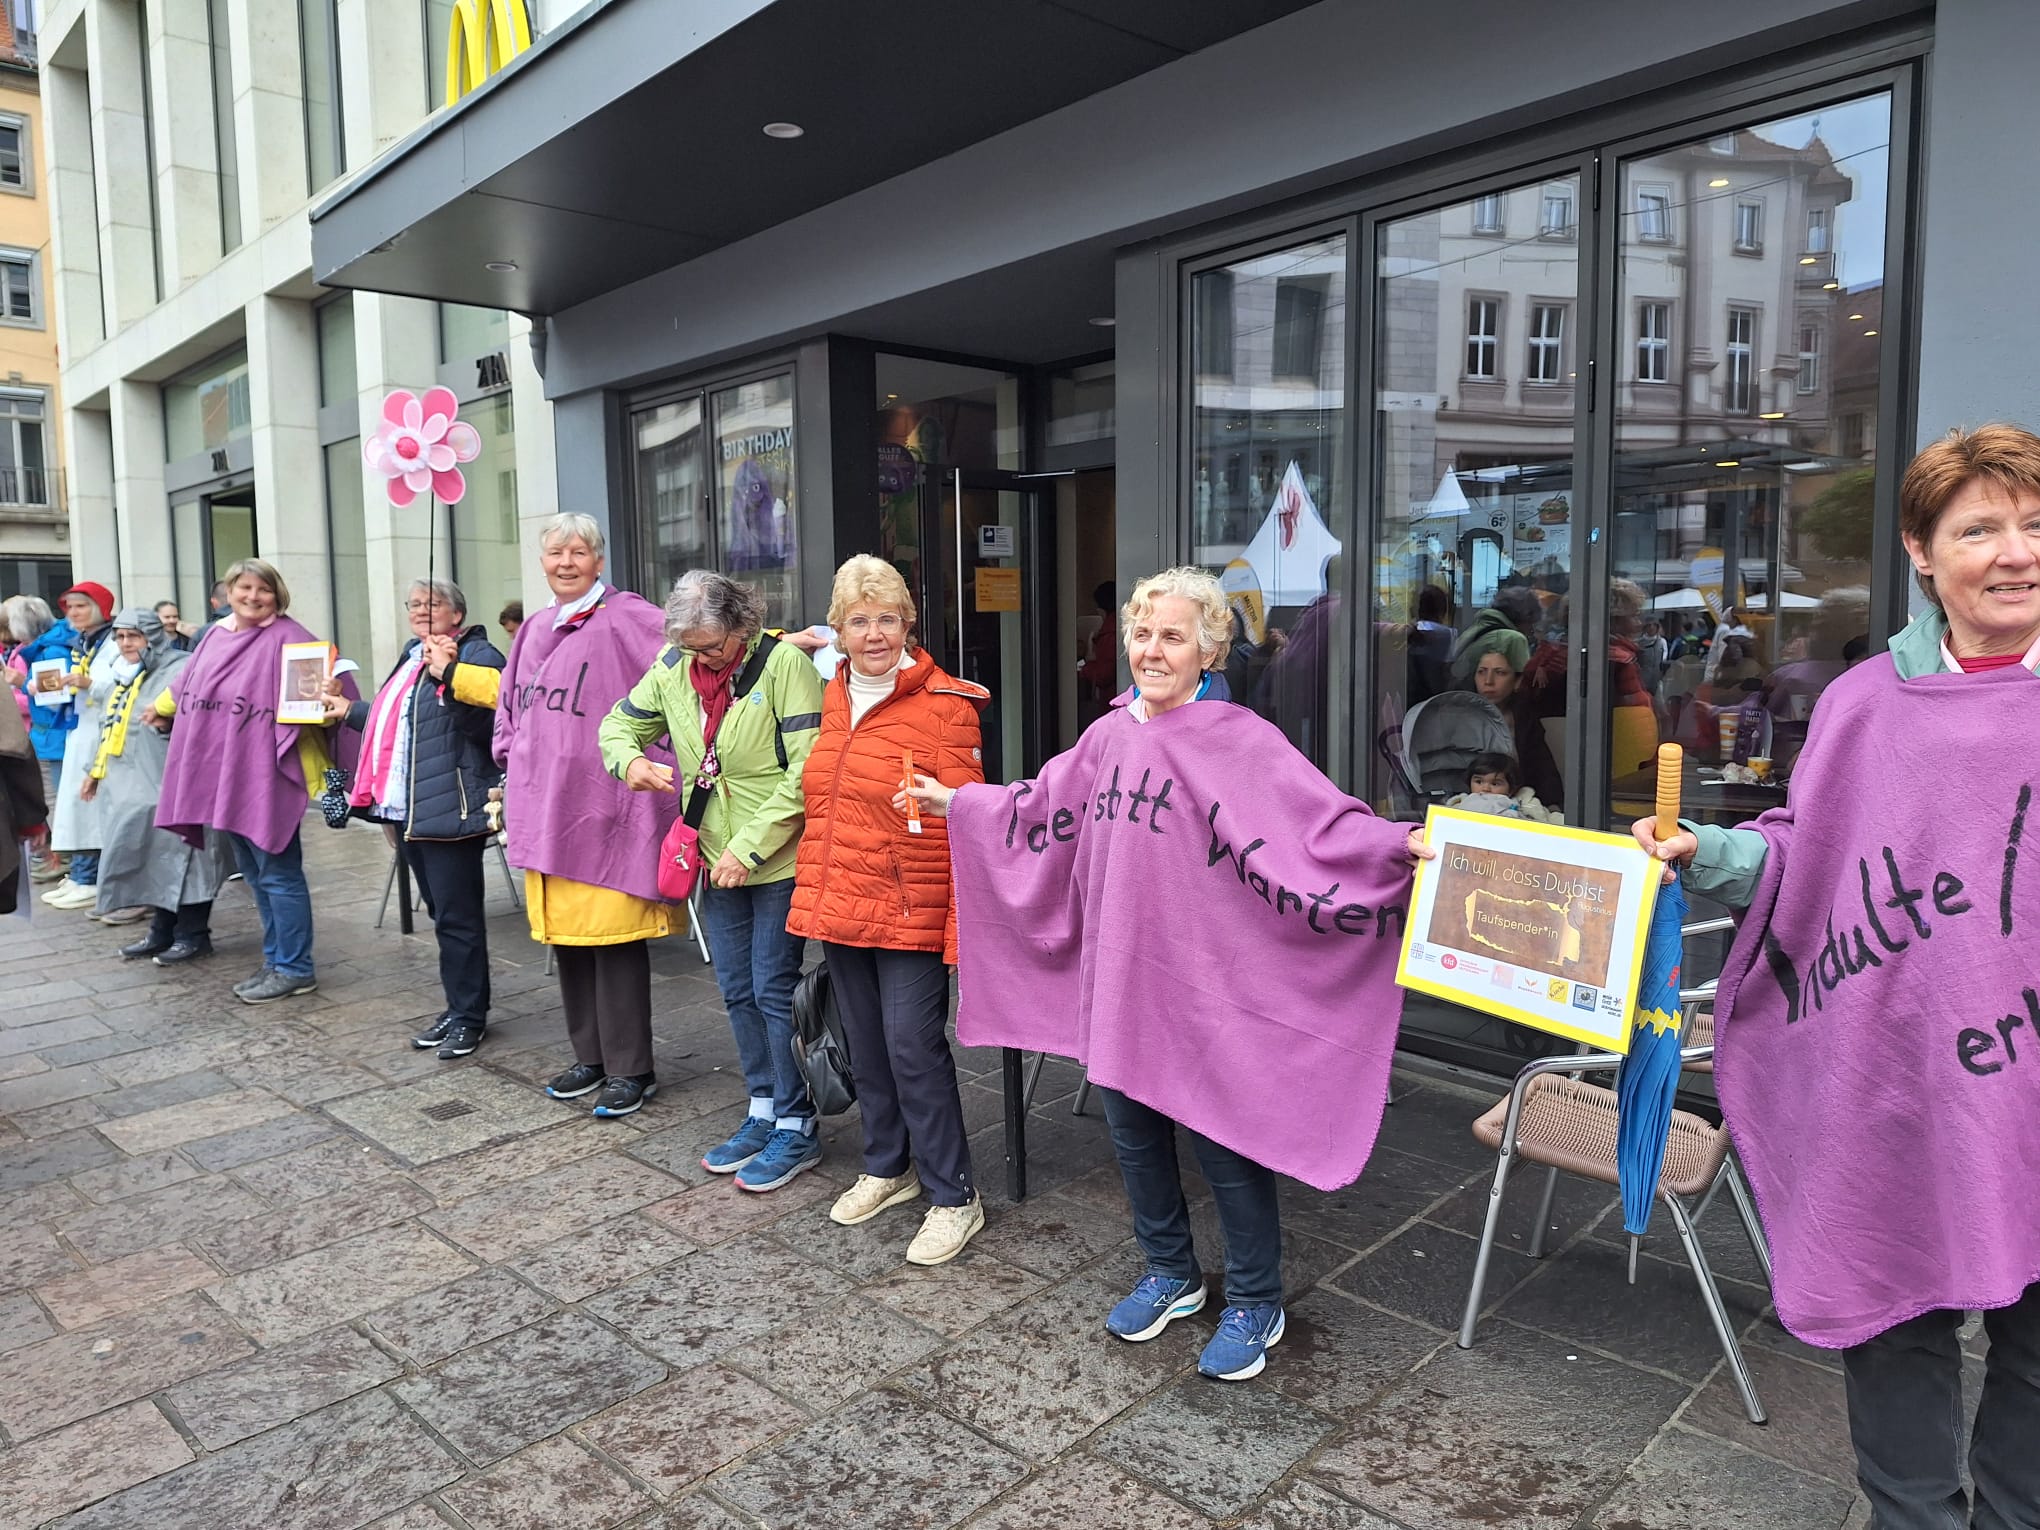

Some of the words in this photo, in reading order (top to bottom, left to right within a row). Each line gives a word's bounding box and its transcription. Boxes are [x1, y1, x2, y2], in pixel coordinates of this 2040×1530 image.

[723, 427, 793, 460] BIRTHDAY
[1449, 850, 1469, 872] Ich
[1472, 859, 1499, 881] will,
[1502, 863, 1541, 889] dass
[1544, 871, 1569, 894] Du
[1571, 877, 1606, 903] bist
